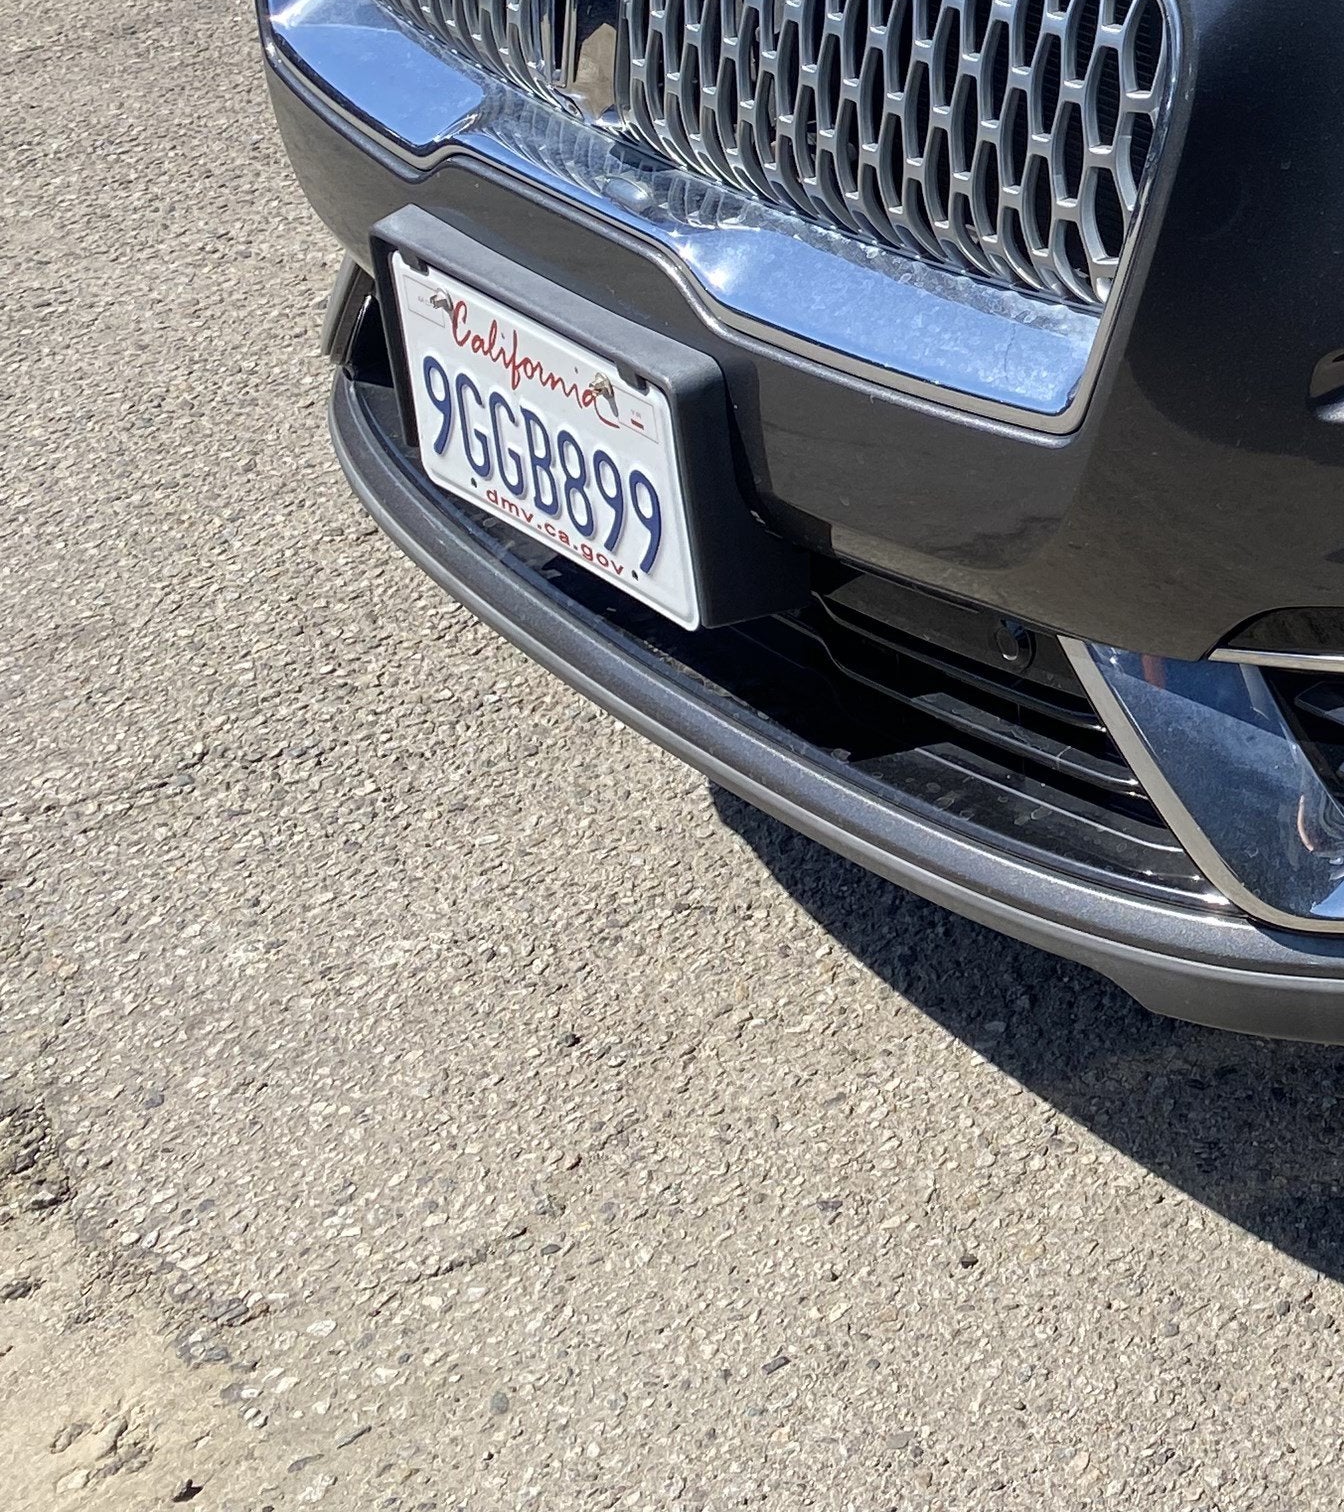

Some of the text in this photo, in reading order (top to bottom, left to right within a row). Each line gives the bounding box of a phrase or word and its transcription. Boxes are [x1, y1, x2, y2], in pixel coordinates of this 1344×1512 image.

[451, 300, 620, 429] California
[422, 355, 664, 575] 9GGB899
[486, 488, 625, 577] dmv.ca.gov
